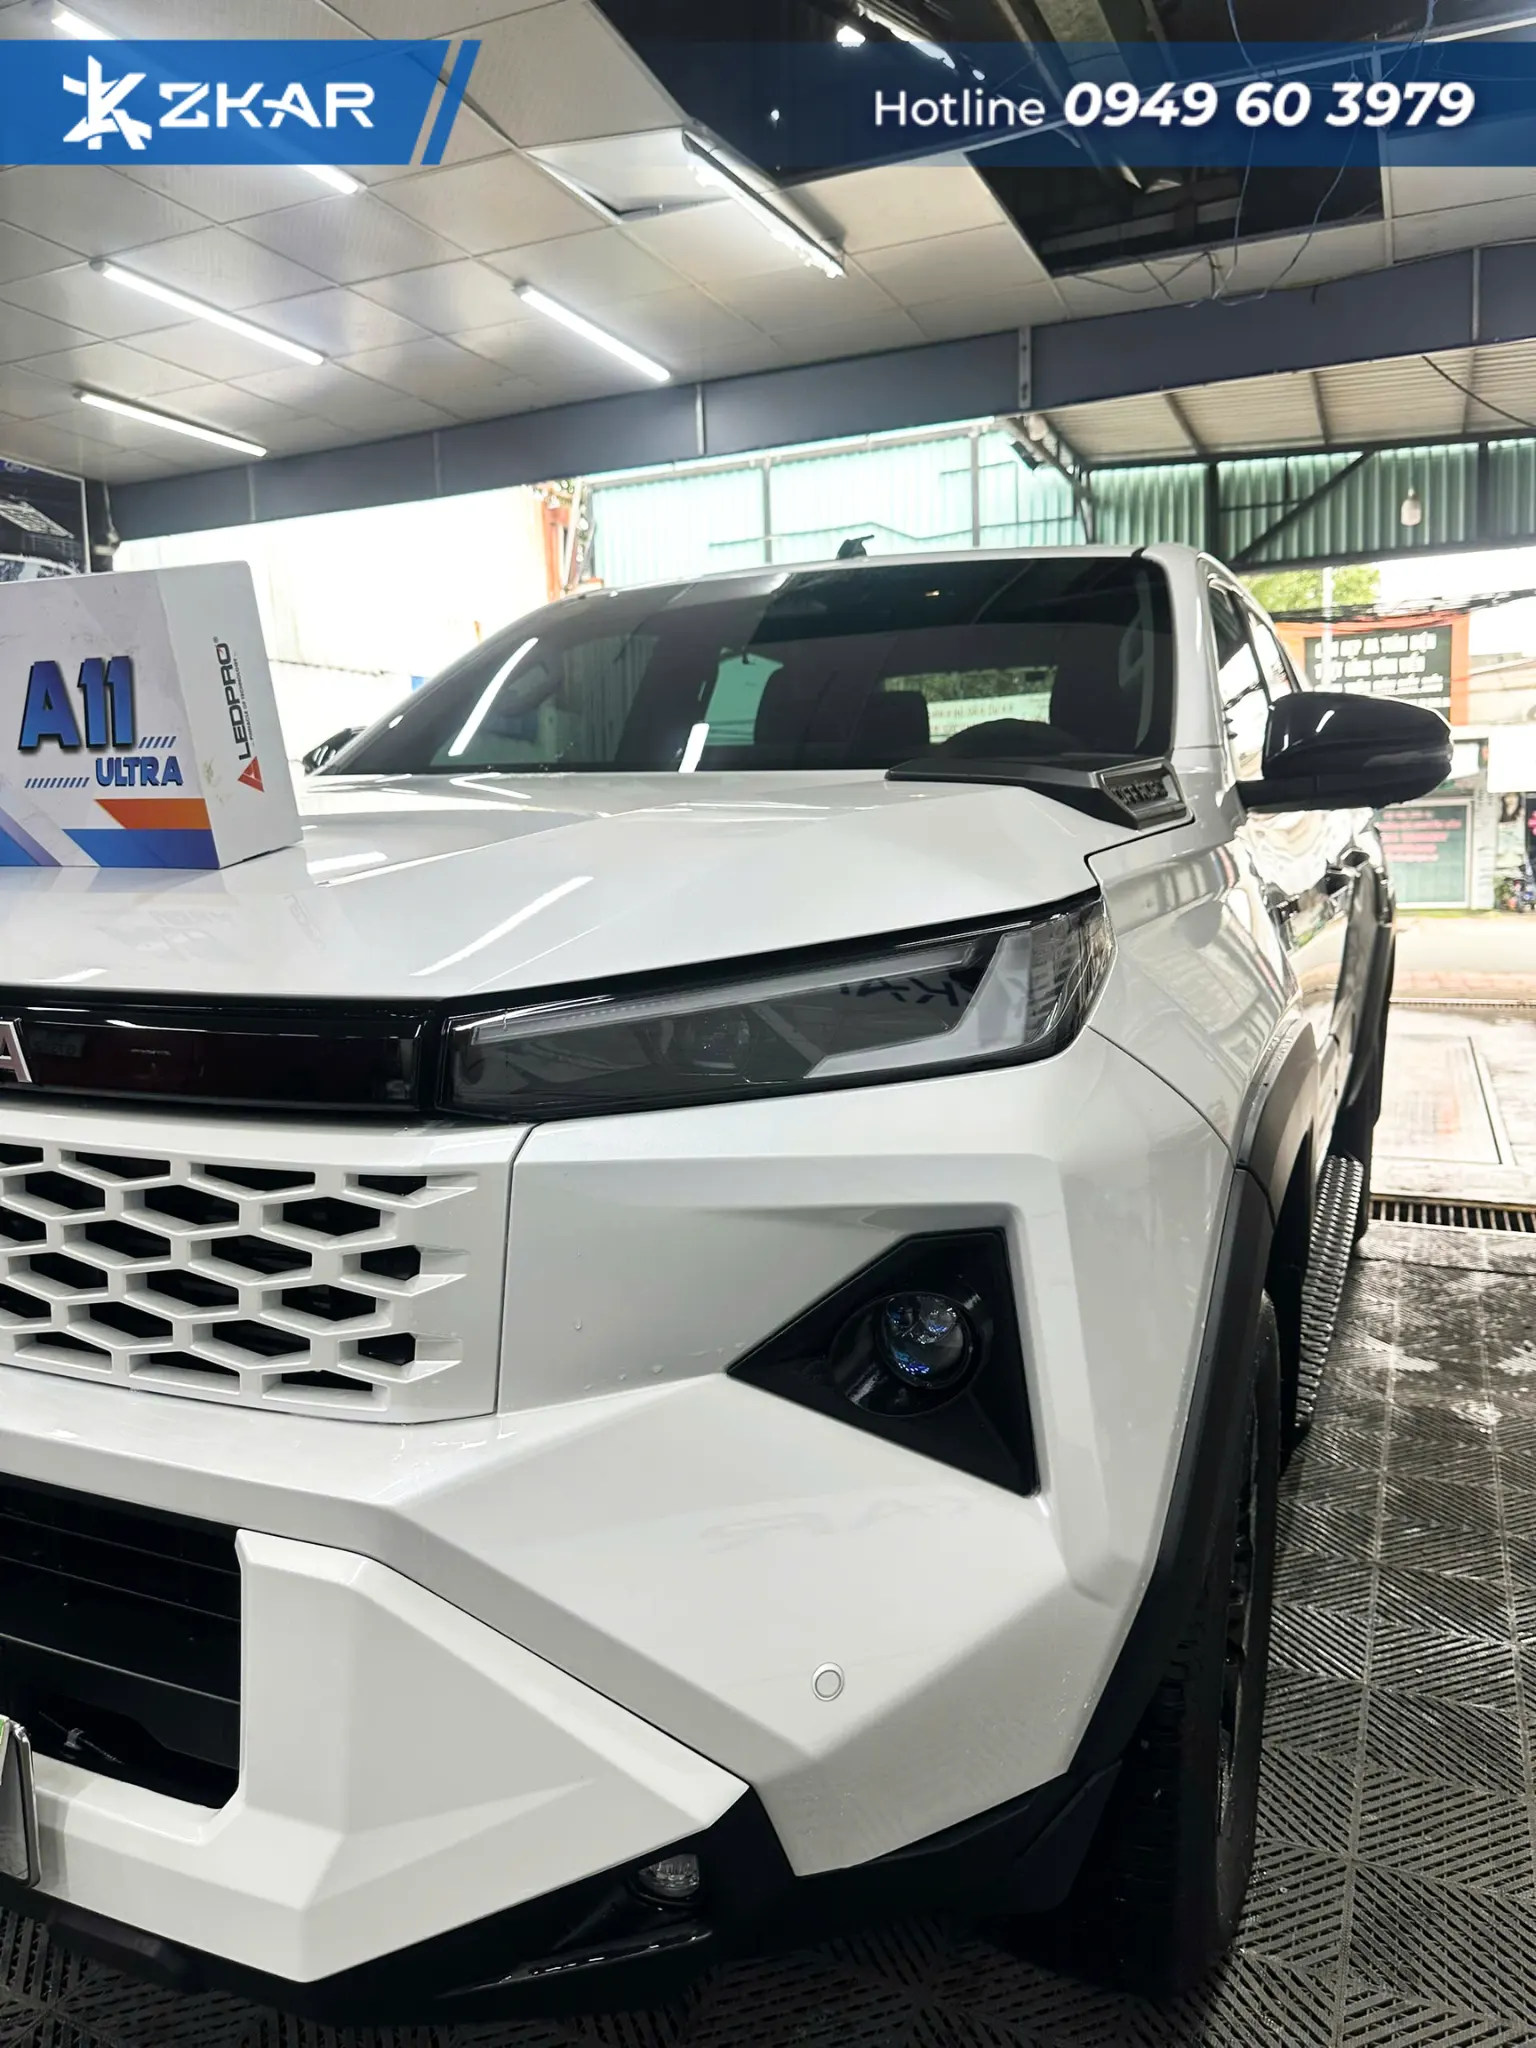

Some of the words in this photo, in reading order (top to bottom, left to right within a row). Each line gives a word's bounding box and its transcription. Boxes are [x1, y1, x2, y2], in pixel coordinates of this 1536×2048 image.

[18, 656, 135, 751] A11
[215, 642, 252, 761] LEDPRO
[95, 756, 183, 787] ULTRA
